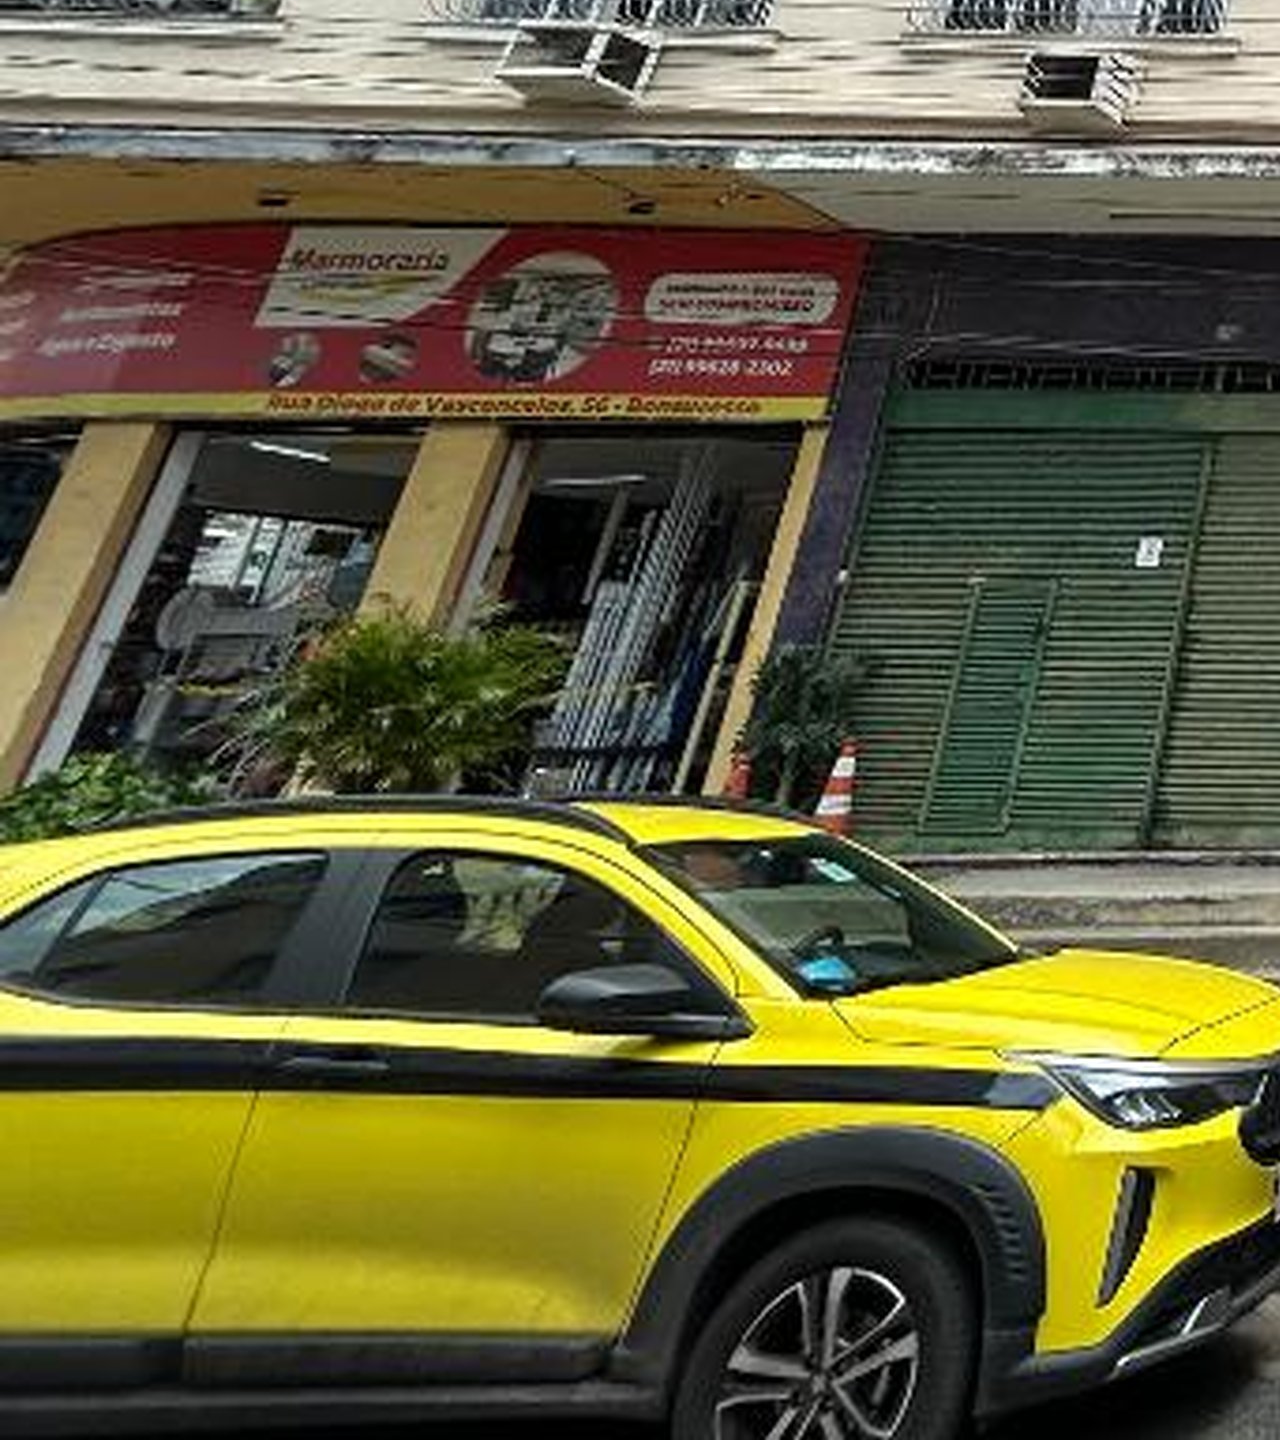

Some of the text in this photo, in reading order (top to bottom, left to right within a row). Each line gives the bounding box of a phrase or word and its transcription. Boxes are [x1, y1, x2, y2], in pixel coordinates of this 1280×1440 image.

[290, 248, 449, 271] Marmoraria
[268, 393, 312, 410] Rua
[390, 396, 421, 411] de
